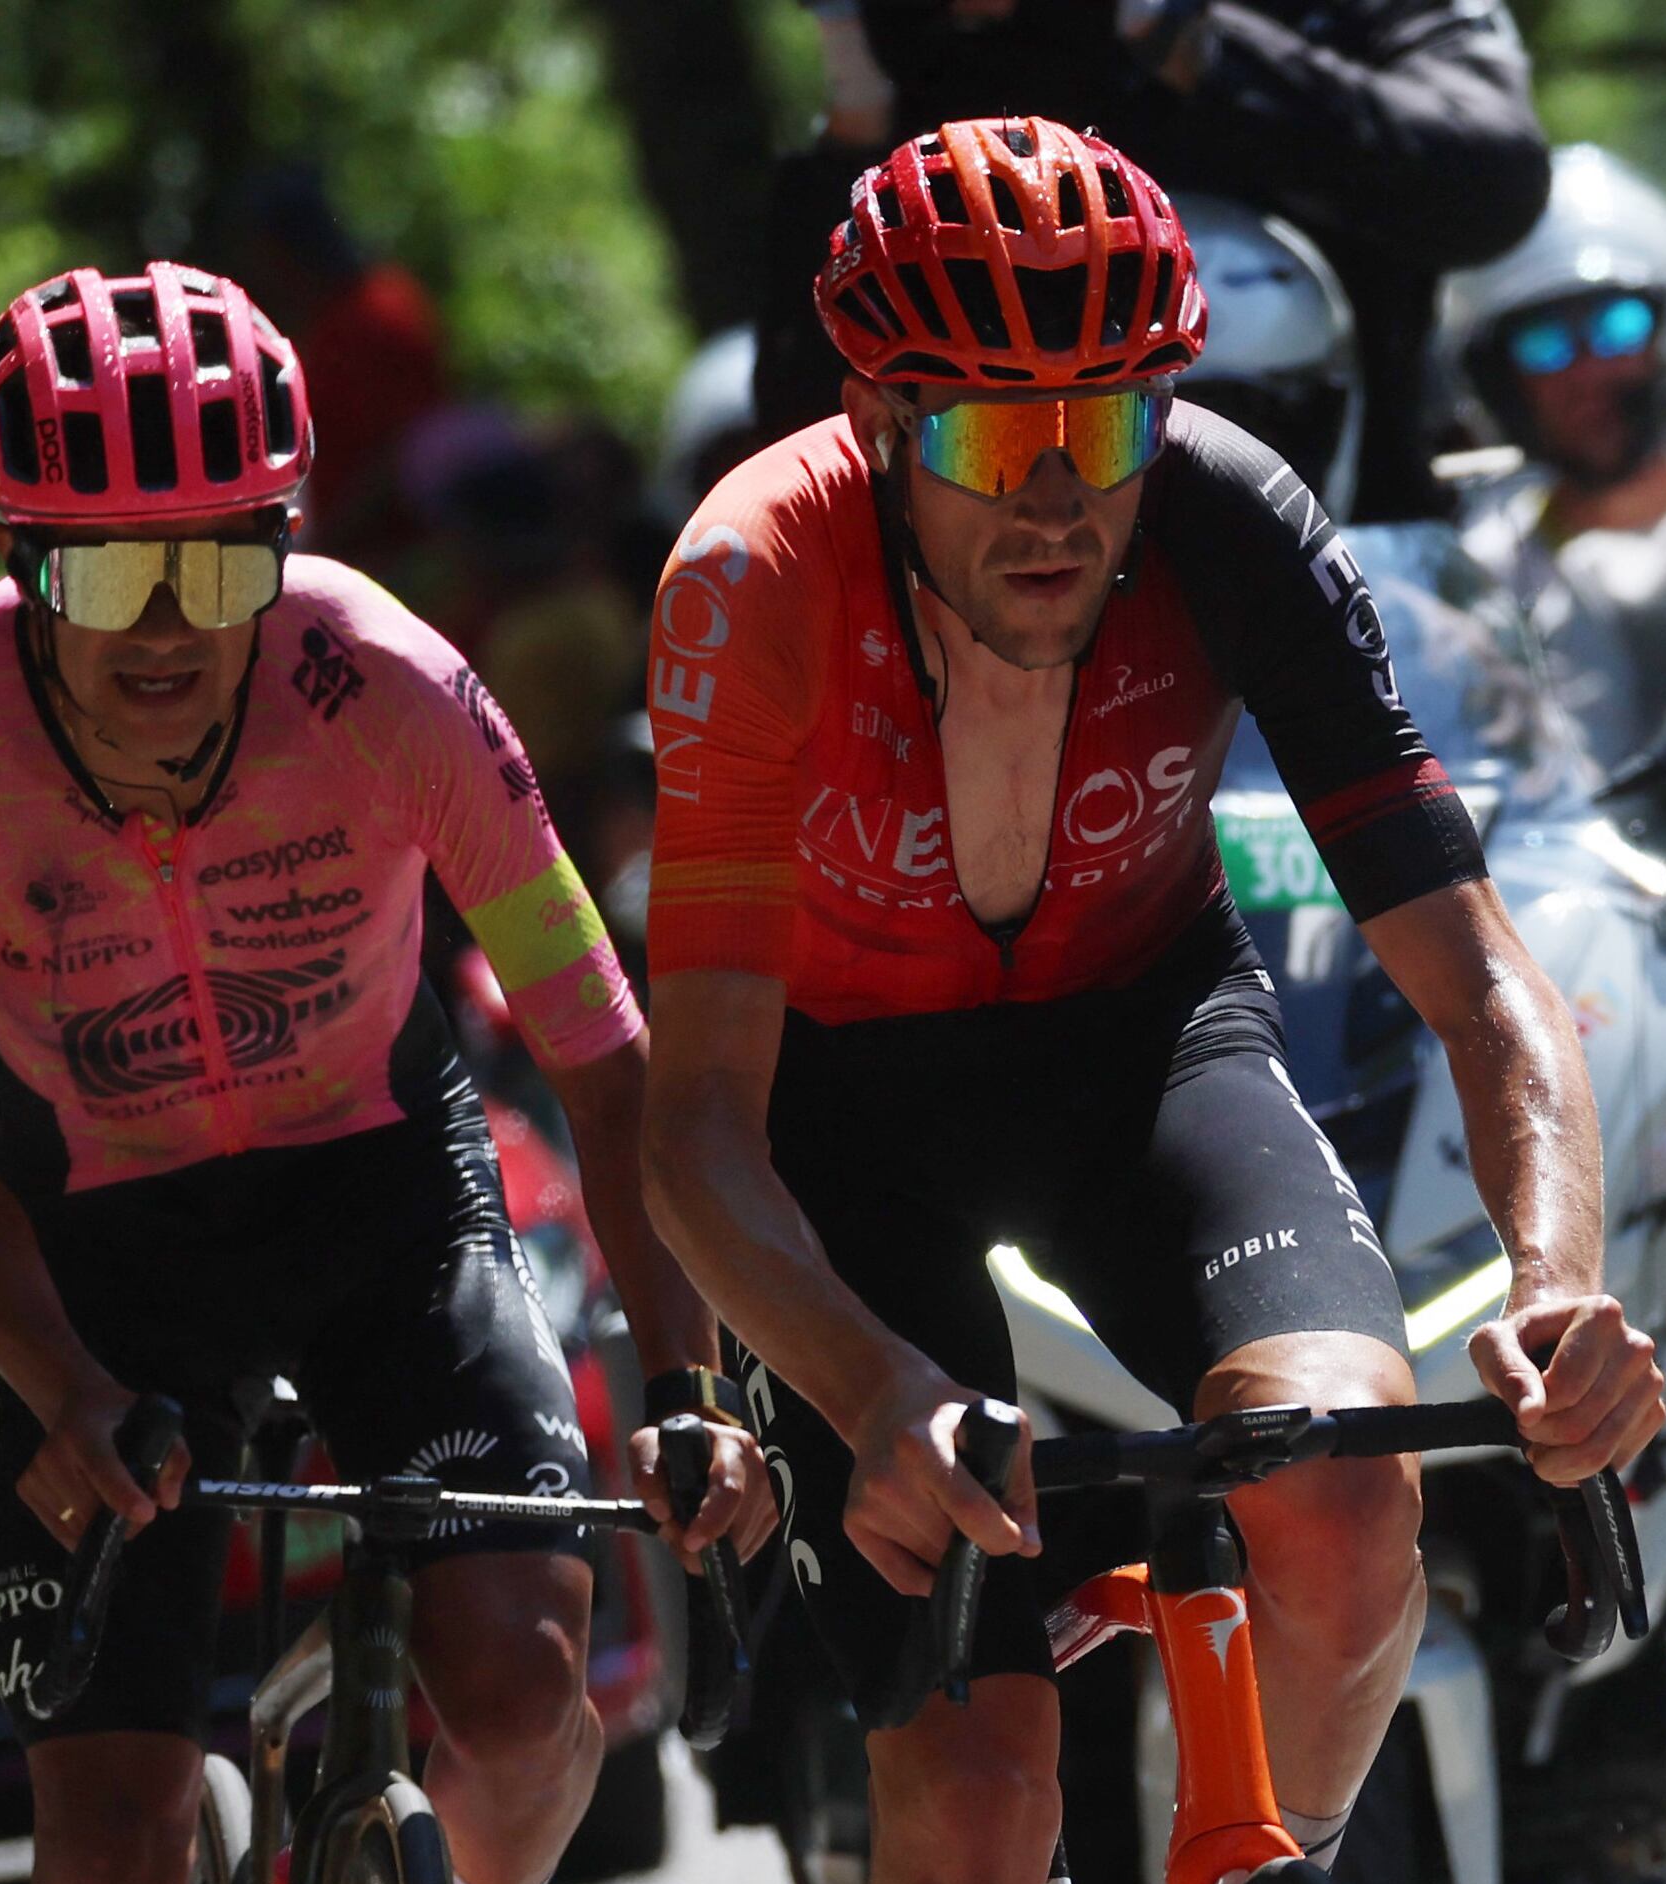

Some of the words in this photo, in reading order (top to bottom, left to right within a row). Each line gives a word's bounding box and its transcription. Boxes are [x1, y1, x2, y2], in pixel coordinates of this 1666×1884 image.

[652, 523, 750, 806] INEOS
[850, 700, 914, 764] GOBIK
[197, 825, 354, 886] easypost
[227, 887, 363, 923] wahoo
[41, 937, 154, 975] NIPPO
[1203, 1227, 1300, 1281] GOBIK
[1241, 1412, 1291, 1426] GARMIN
[454, 1493, 574, 1517] cannondale
